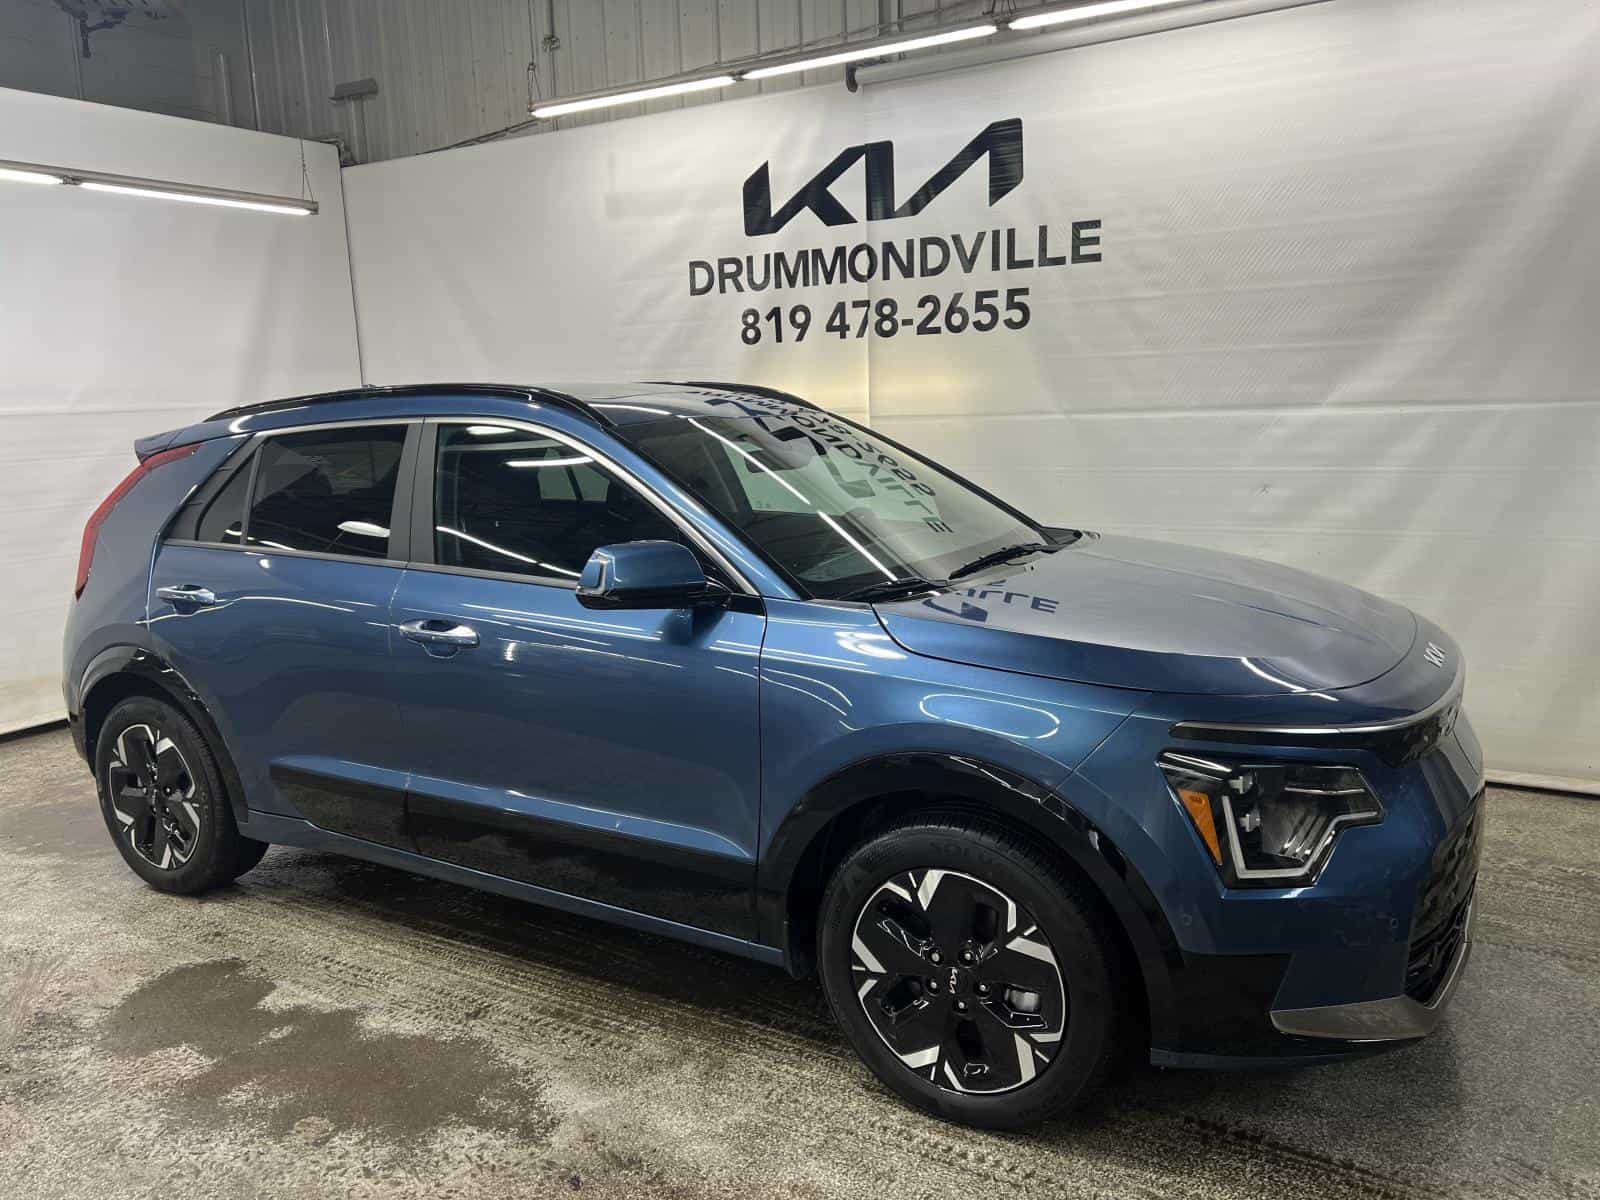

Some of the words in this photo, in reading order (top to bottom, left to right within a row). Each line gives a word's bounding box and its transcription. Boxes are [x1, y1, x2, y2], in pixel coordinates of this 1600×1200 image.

[743, 117, 1023, 236] KIA
[689, 219, 1102, 296] DRUMMONDVILLE
[741, 306, 811, 345] 819
[825, 287, 1031, 340] 478-2655
